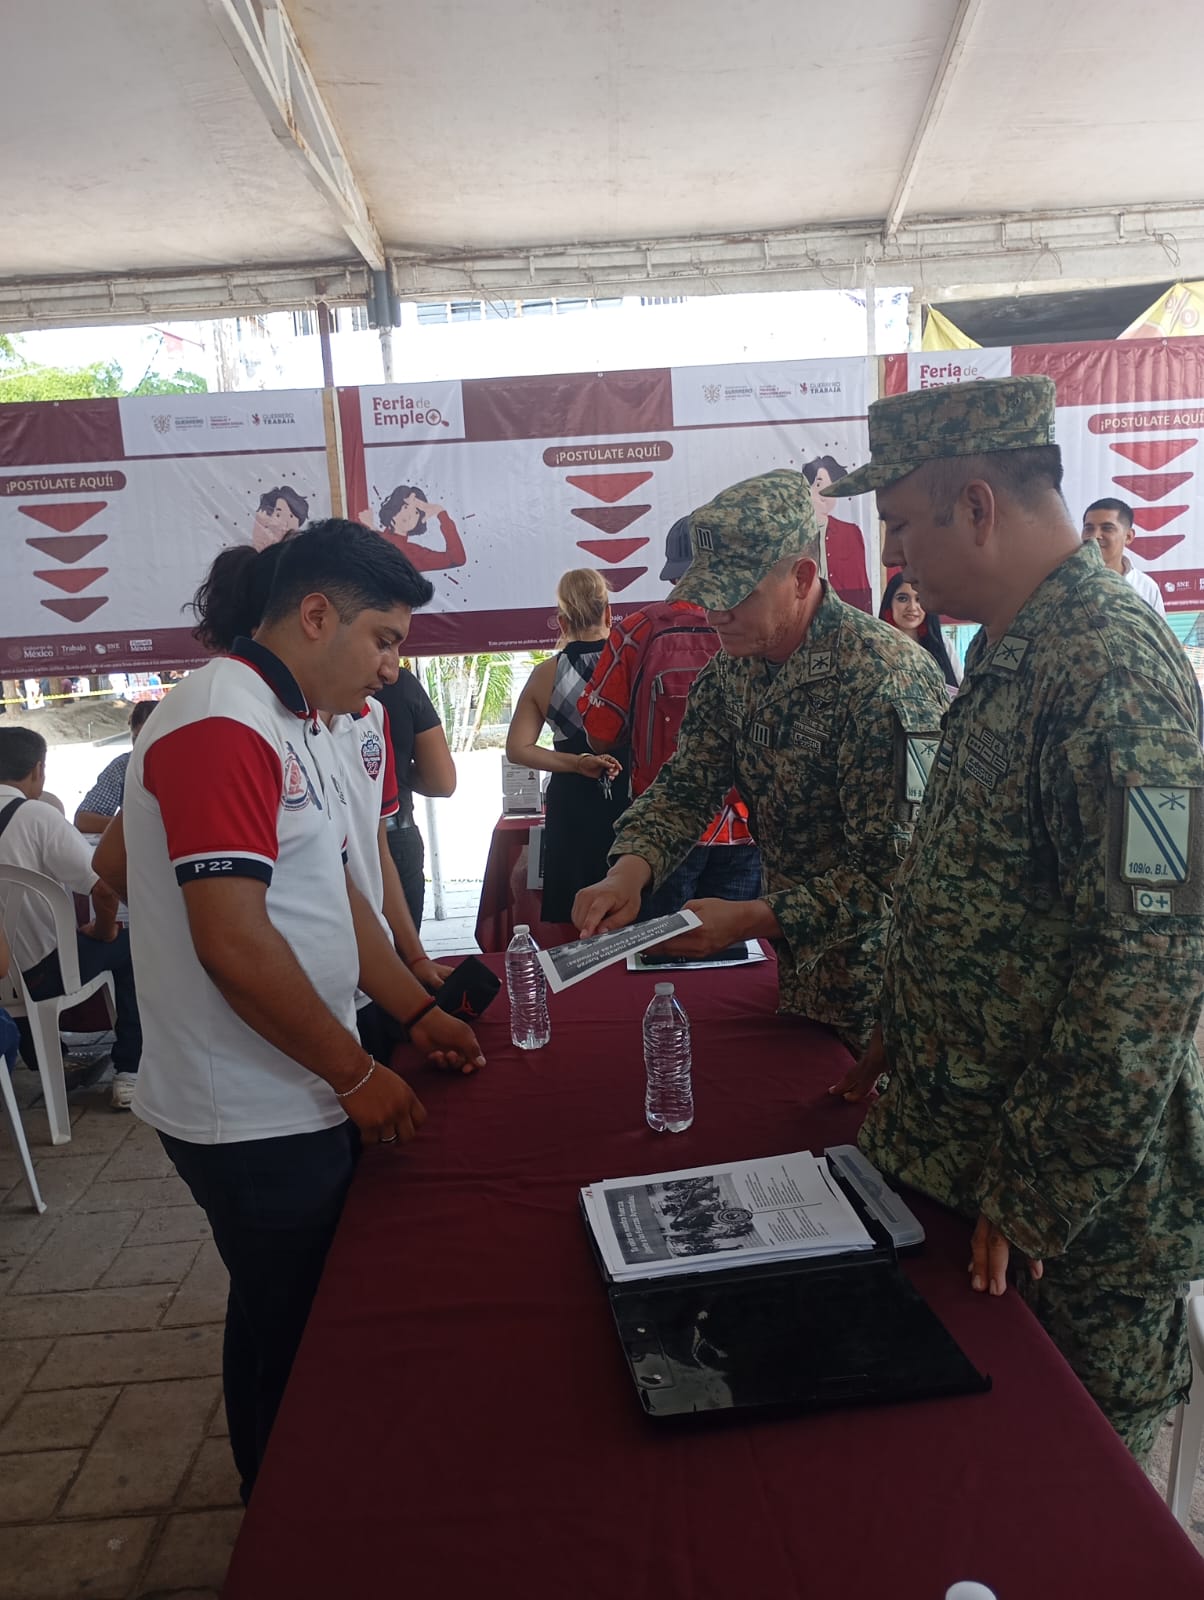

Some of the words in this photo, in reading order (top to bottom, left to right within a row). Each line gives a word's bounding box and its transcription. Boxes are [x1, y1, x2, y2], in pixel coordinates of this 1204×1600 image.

[920, 363, 961, 378] Feria
[964, 365, 978, 376] de
[372, 395, 414, 411] Feria
[416, 398, 430, 409] de
[1101, 415, 1170, 431] ¡POSTÚLATE
[556, 447, 624, 464] ¡POSTÚLATE
[627, 444, 661, 459] AQUÍ!
[6, 477, 76, 494] ¡POSTÚLATE
[80, 473, 114, 489] AQUÍ!
[24, 649, 54, 658] México
[1129, 862, 1153, 875] 109/o.
